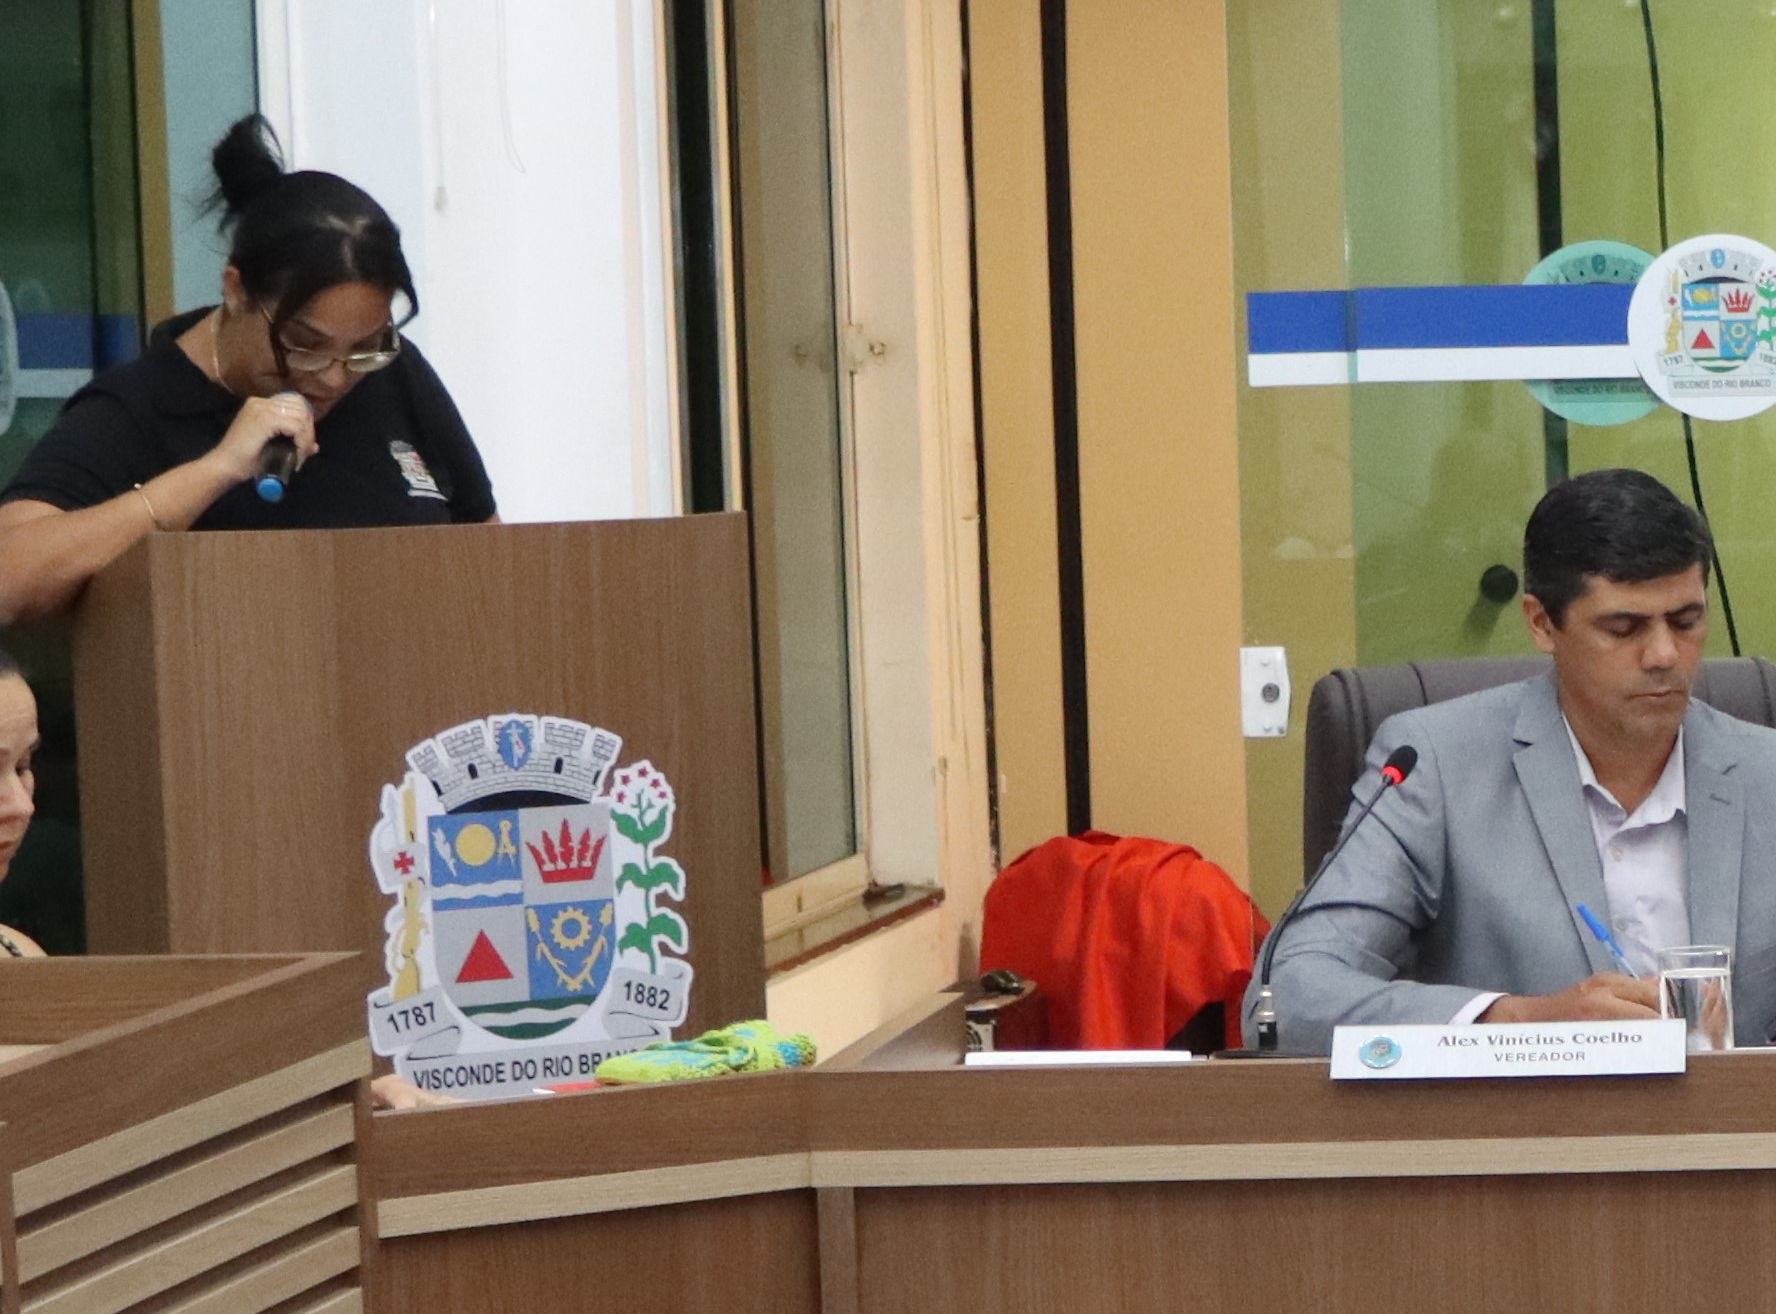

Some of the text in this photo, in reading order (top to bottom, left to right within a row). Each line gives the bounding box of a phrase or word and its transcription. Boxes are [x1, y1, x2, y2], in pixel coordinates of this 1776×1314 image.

[1673, 380, 1710, 389] VISCONDE
[1739, 379, 1772, 388] BRANCO
[623, 980, 670, 1011] 1882
[386, 1001, 437, 1034] 1787
[1437, 1031, 1643, 1047] Alex Vinícius Coelho
[1494, 1051, 1586, 1063] VEREADOR
[413, 1061, 506, 1090] VISCONDE
[512, 1059, 537, 1082] DO
[543, 1055, 573, 1078] RIO
